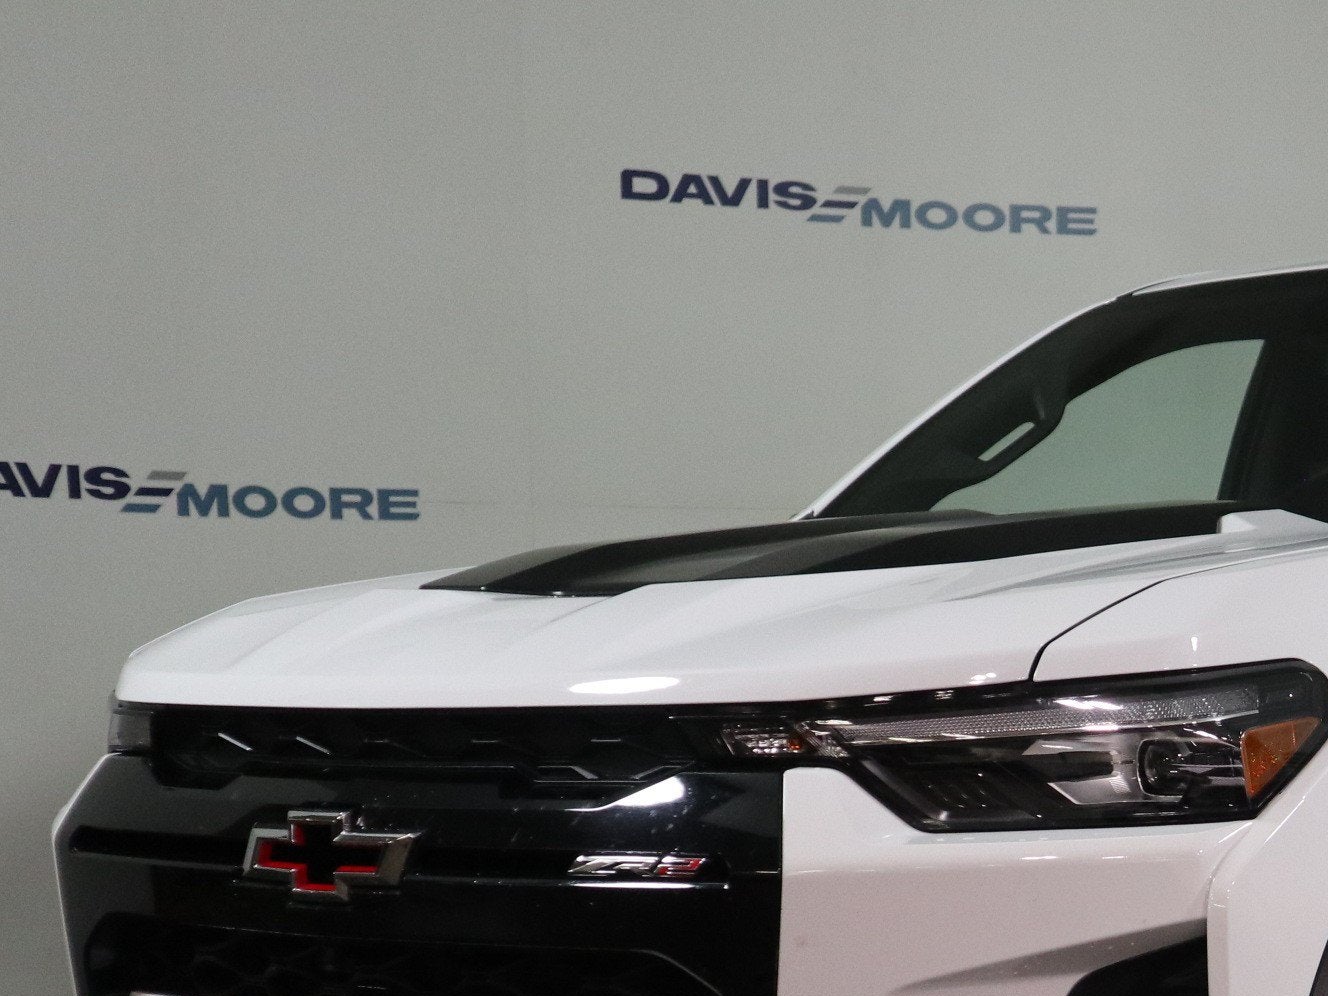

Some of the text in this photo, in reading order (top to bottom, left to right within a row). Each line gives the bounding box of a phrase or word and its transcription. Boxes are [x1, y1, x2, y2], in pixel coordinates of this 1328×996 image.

[620, 169, 1098, 236] DAVIS MOORE
[176, 483, 420, 521] MOORE
[567, 853, 706, 878] ZR2
